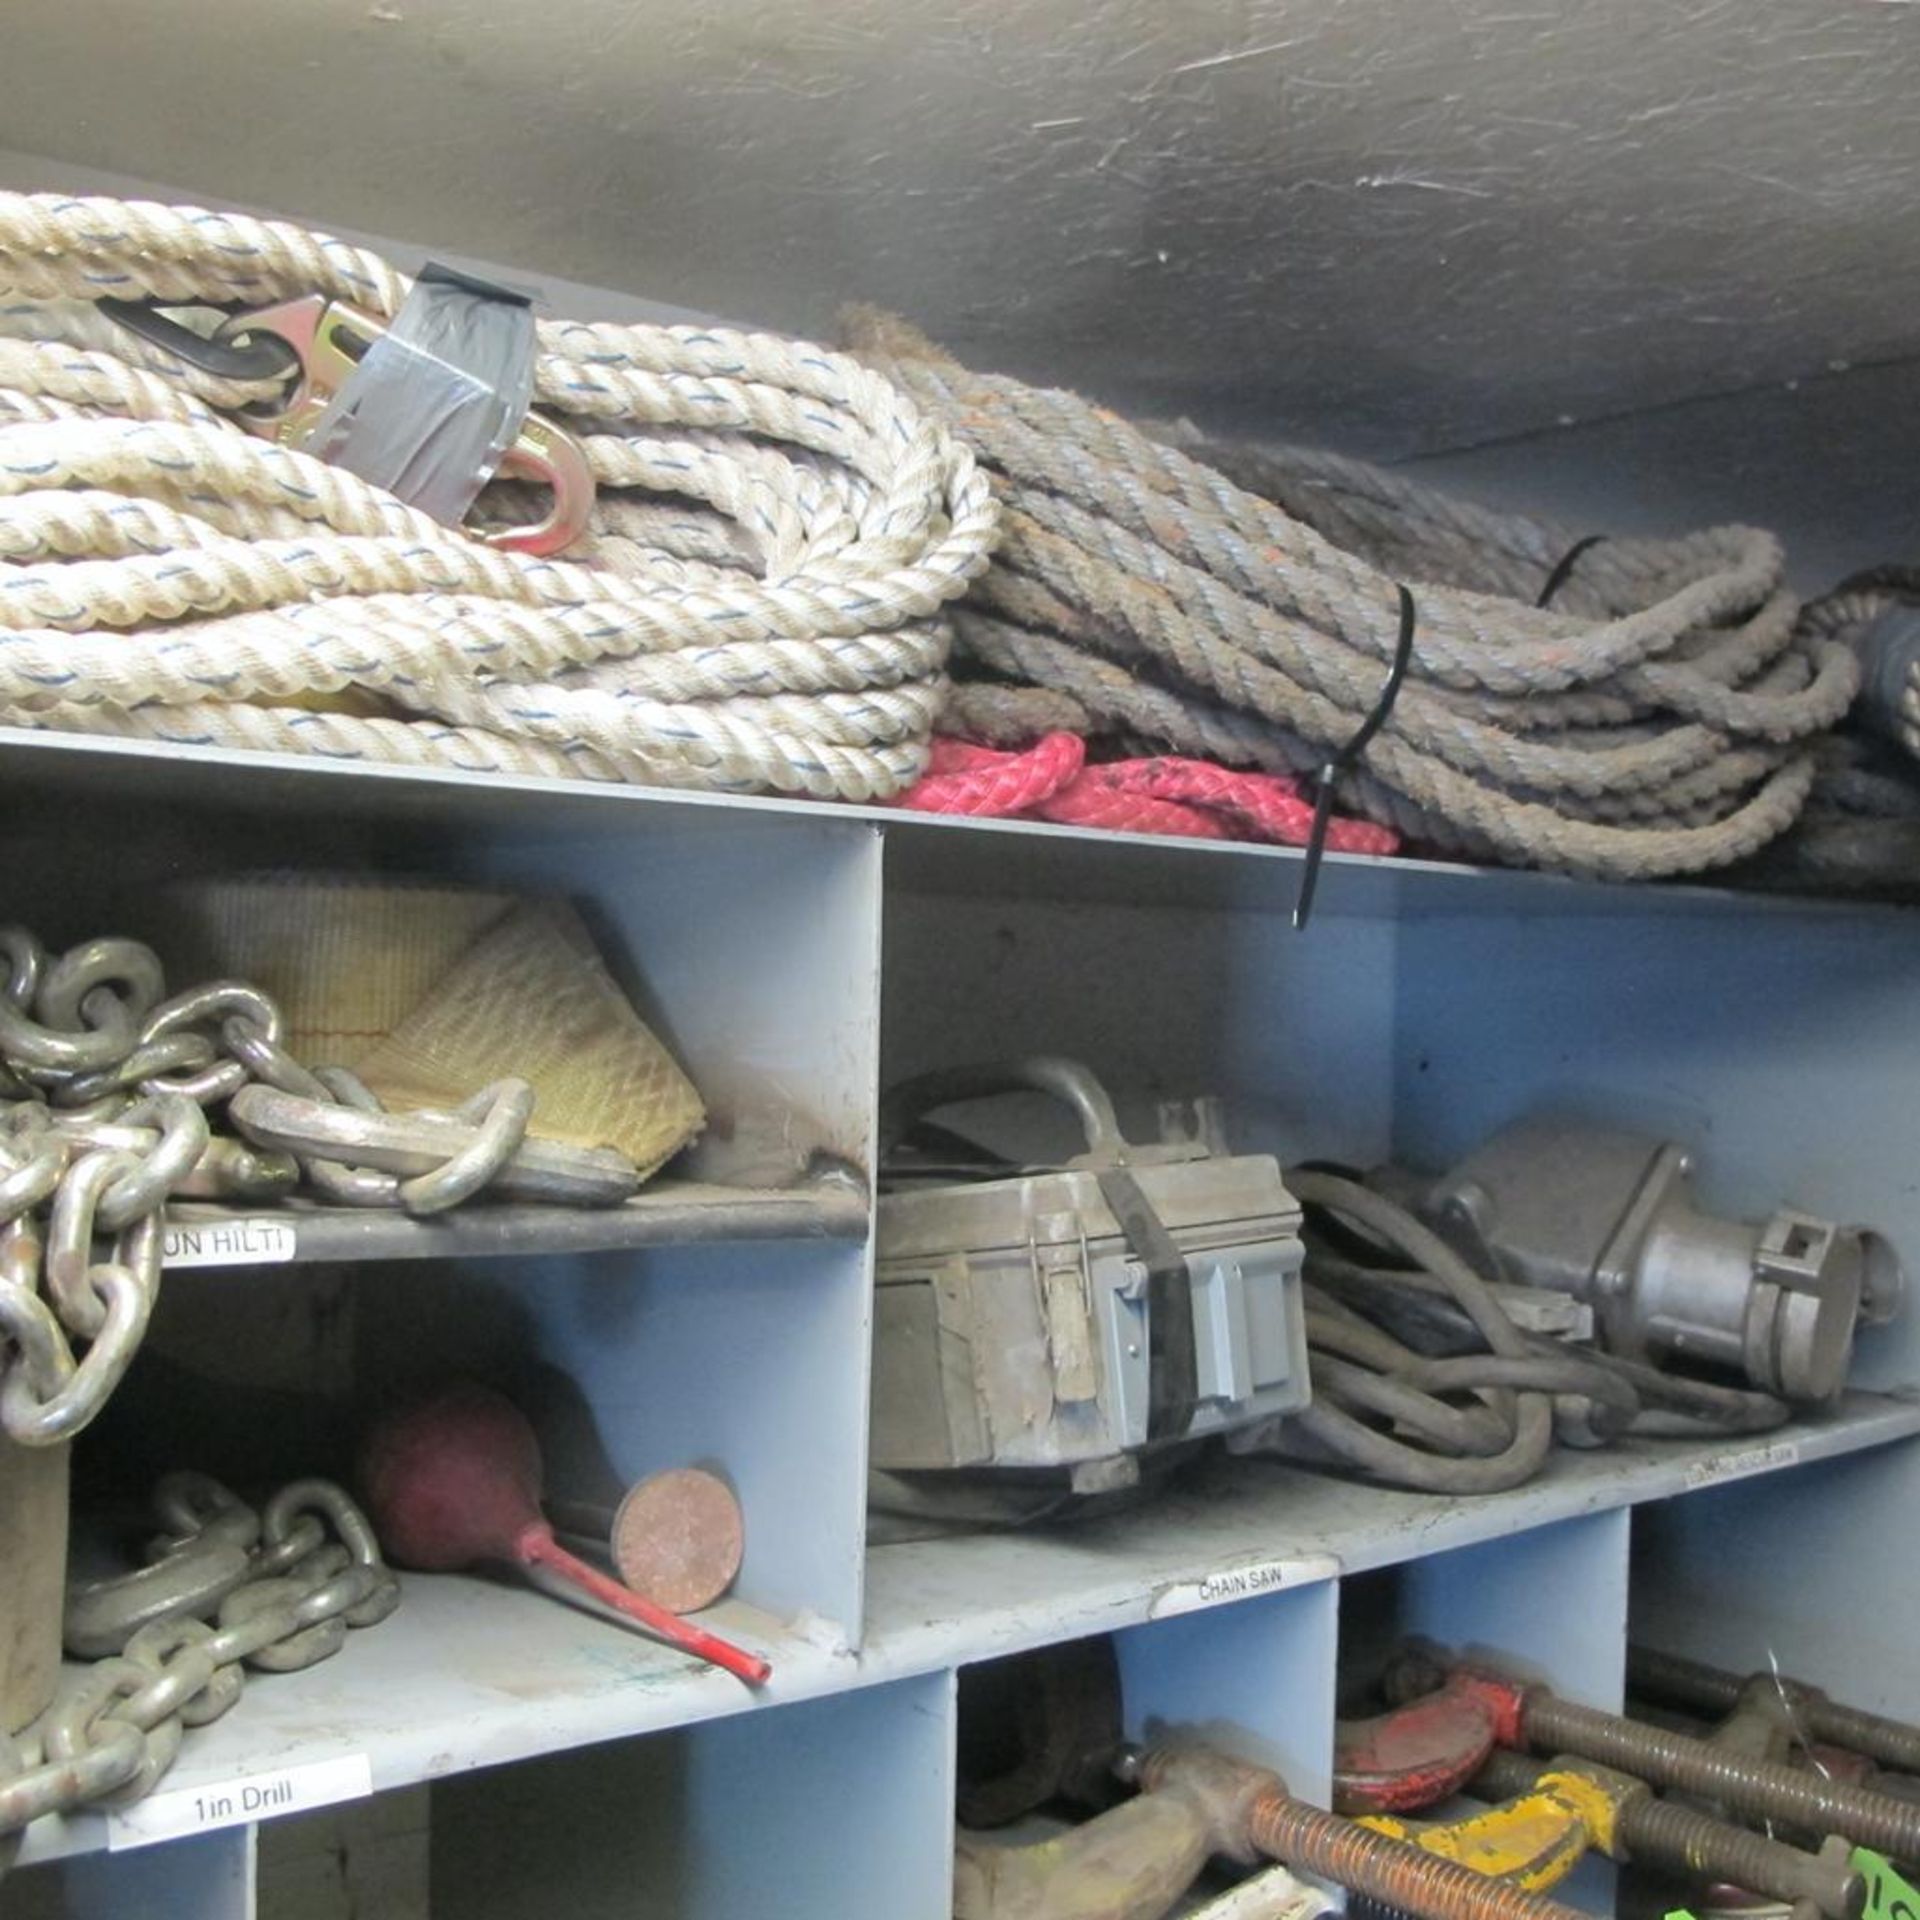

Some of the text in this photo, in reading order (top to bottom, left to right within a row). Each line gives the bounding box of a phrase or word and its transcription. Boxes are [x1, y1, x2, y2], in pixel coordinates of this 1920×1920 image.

[212, 1227, 284, 1255] HILTI
[1198, 1566, 1284, 1601] CHAIN SAW
[194, 1779, 293, 1822] 1in Drill
